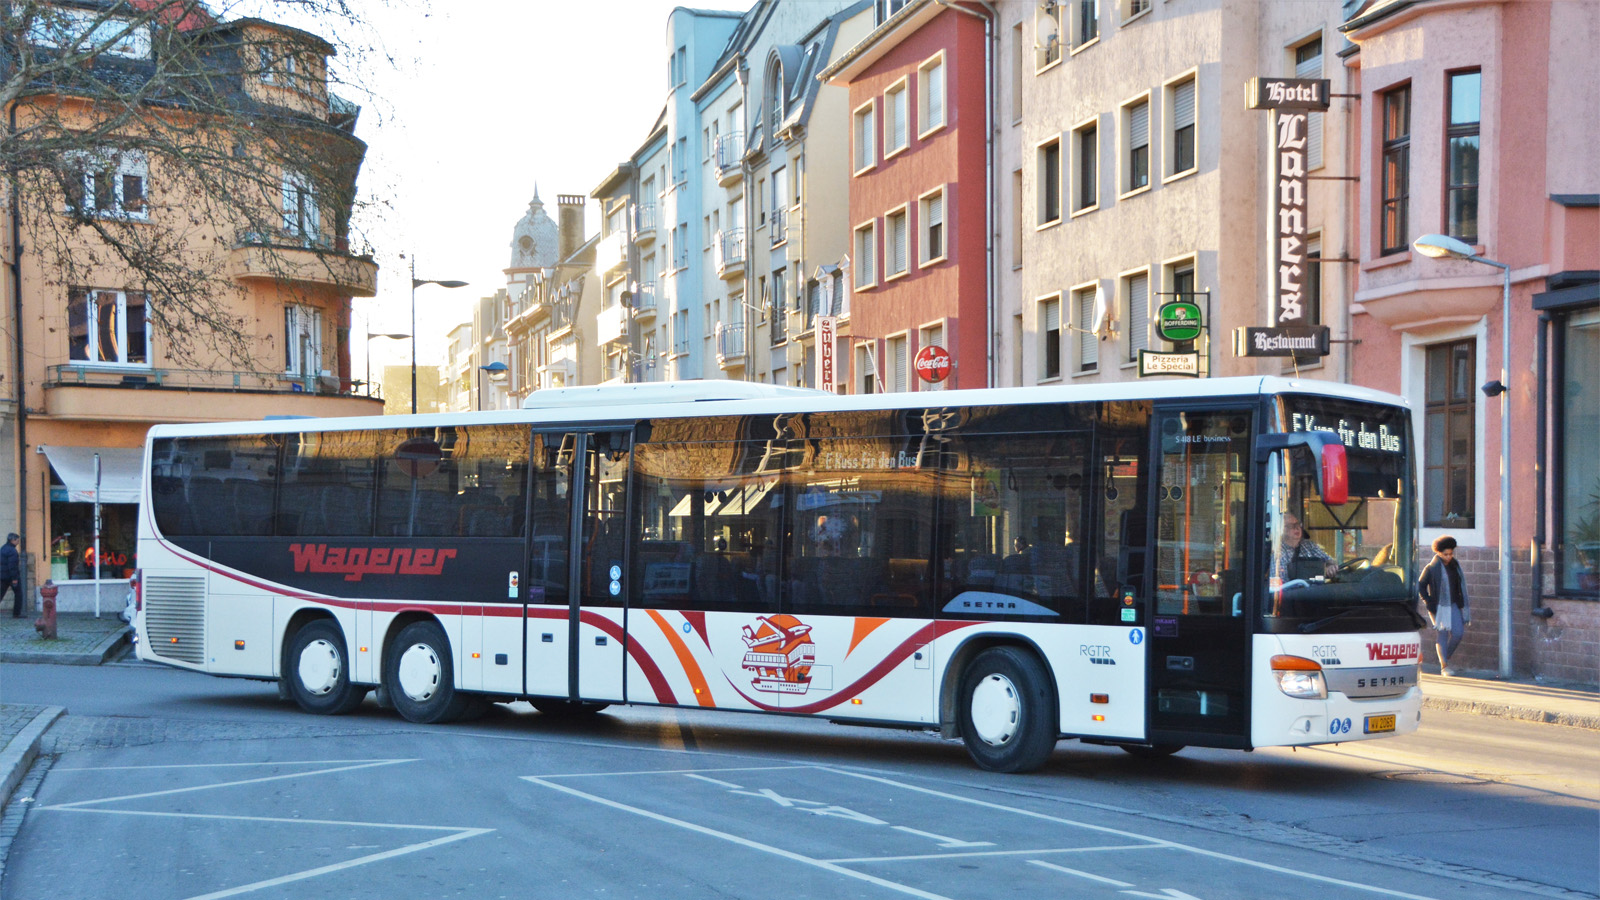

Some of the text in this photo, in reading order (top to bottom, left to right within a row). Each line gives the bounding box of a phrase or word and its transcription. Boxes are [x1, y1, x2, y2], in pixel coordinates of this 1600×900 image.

[1265, 81, 1318, 105] Hotel
[1277, 113, 1306, 322] Lanners
[1254, 331, 1317, 352] Restaurant
[1147, 362, 1194, 371] Le Special
[1193, 435, 1202, 443] LE
[1358, 421, 1378, 449] den
[1379, 424, 1400, 452] Bus
[879, 451, 896, 468] den
[899, 451, 917, 468] Bus
[288, 543, 458, 581] Wagener
[963, 601, 1016, 609] SETRA
[1079, 644, 1111, 657] RGTR
[1311, 645, 1338, 657] RGTR
[1366, 642, 1420, 664] Wagener
[1357, 676, 1405, 688] SETRA
